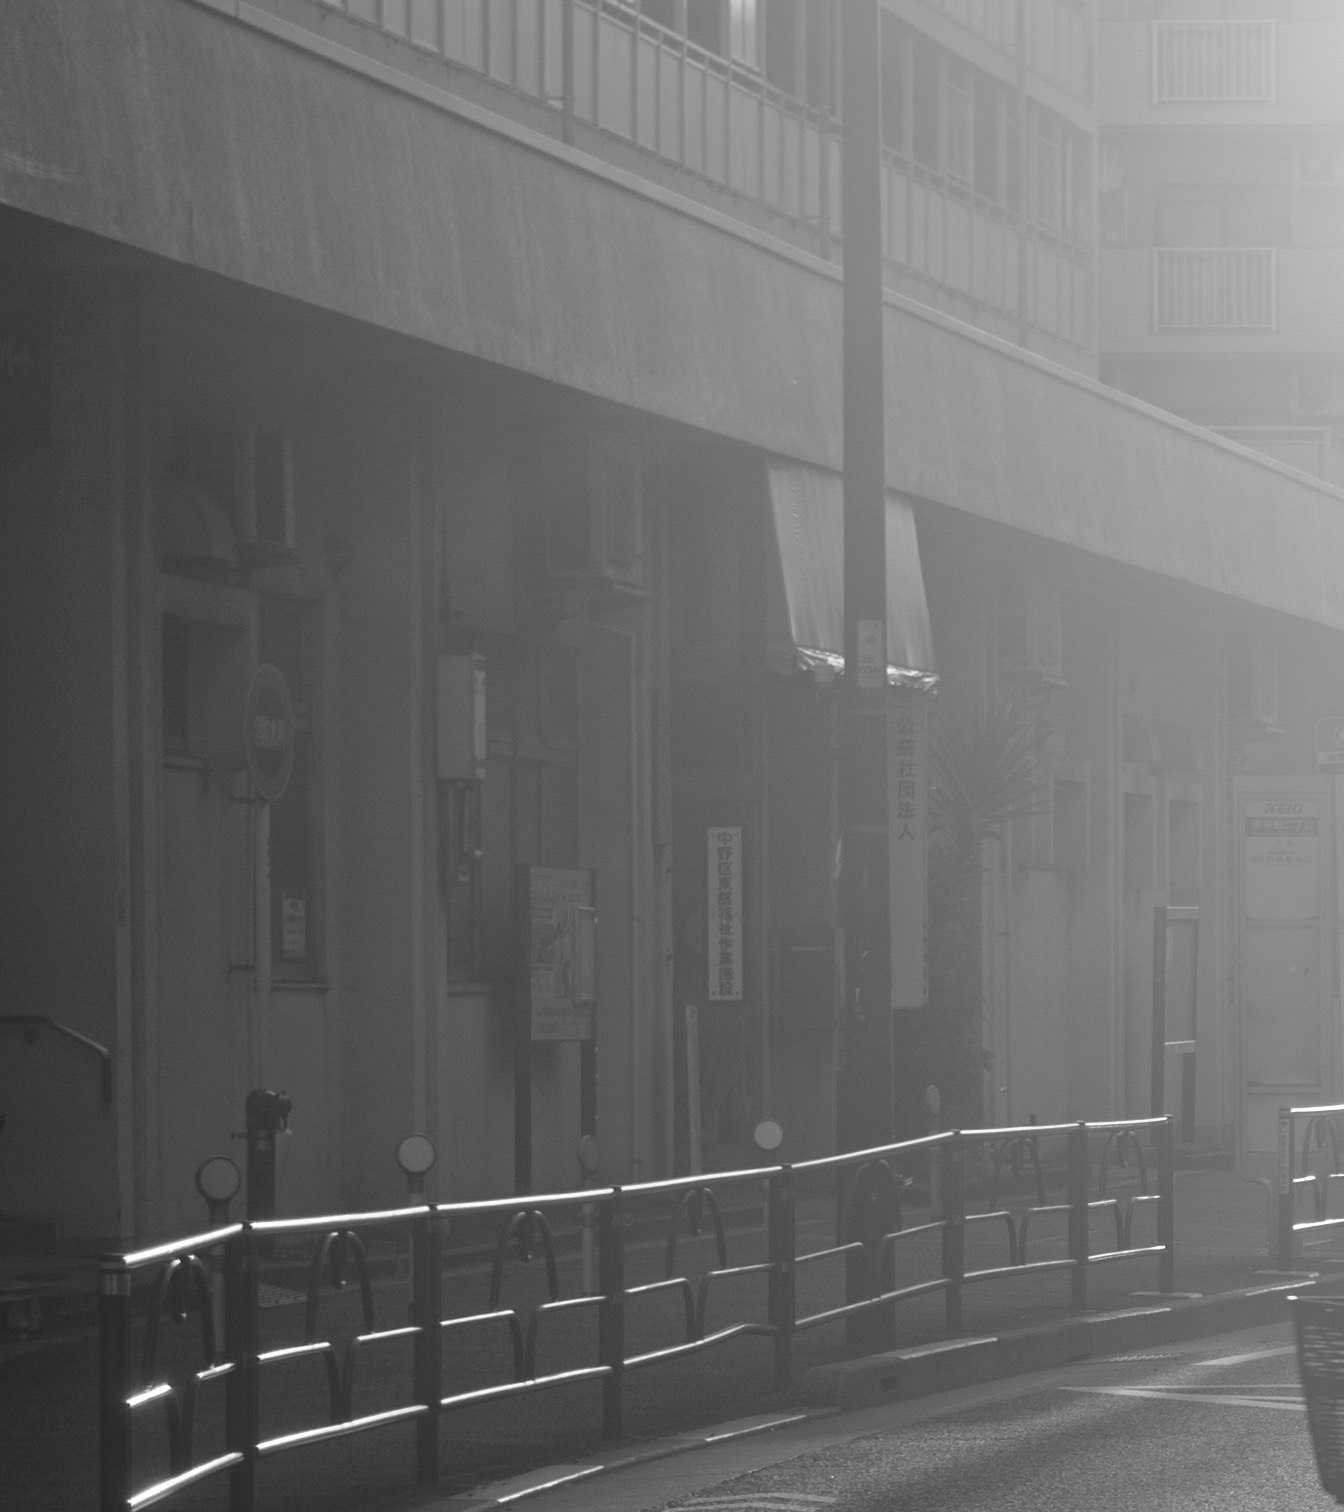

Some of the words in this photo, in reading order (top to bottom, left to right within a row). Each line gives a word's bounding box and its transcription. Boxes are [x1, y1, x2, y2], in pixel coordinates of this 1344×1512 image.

[896, 716, 916, 841] 公益社団法人
[1264, 802, 1304, 815] KEIO
[716, 831, 735, 997] 中野区東部福祉作業施設
